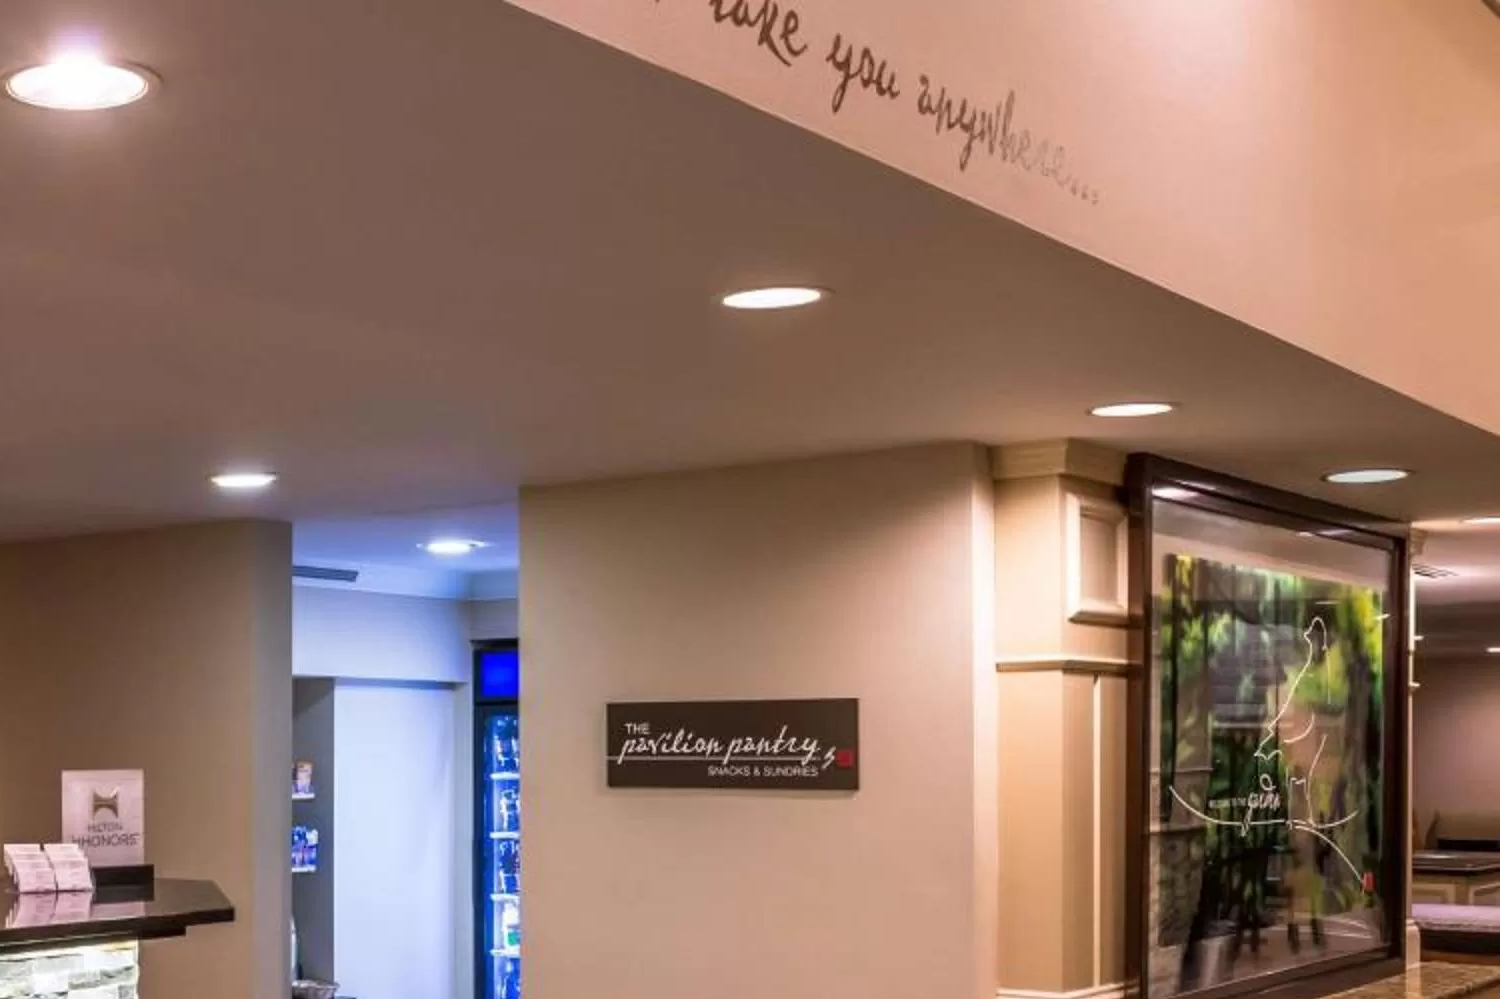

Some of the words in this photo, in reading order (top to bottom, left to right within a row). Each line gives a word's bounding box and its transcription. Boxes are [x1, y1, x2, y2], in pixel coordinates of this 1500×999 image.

[825, 33, 900, 114] you
[625, 722, 650, 735] THE
[616, 728, 722, 765] pavilion
[723, 725, 821, 766] pantry
[707, 765, 750, 777] SNACKS
[763, 765, 819, 777] SUNDRIES
